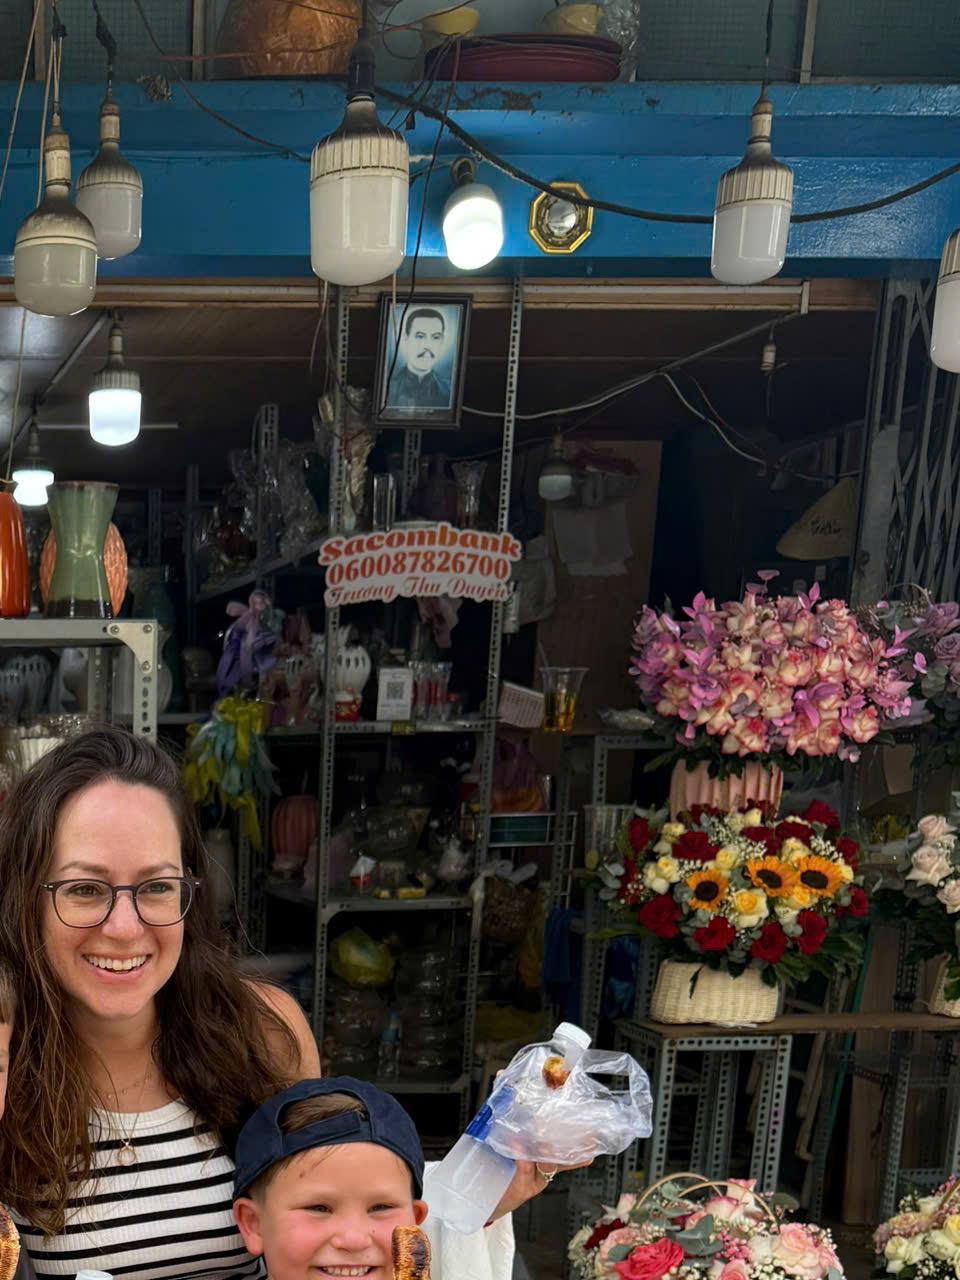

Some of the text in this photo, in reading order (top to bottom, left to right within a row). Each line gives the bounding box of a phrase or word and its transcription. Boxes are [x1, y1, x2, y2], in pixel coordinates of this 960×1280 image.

[322, 525, 519, 562] Sacombank
[328, 550, 508, 585] 060087826700
[402, 576, 441, 594] Thu
